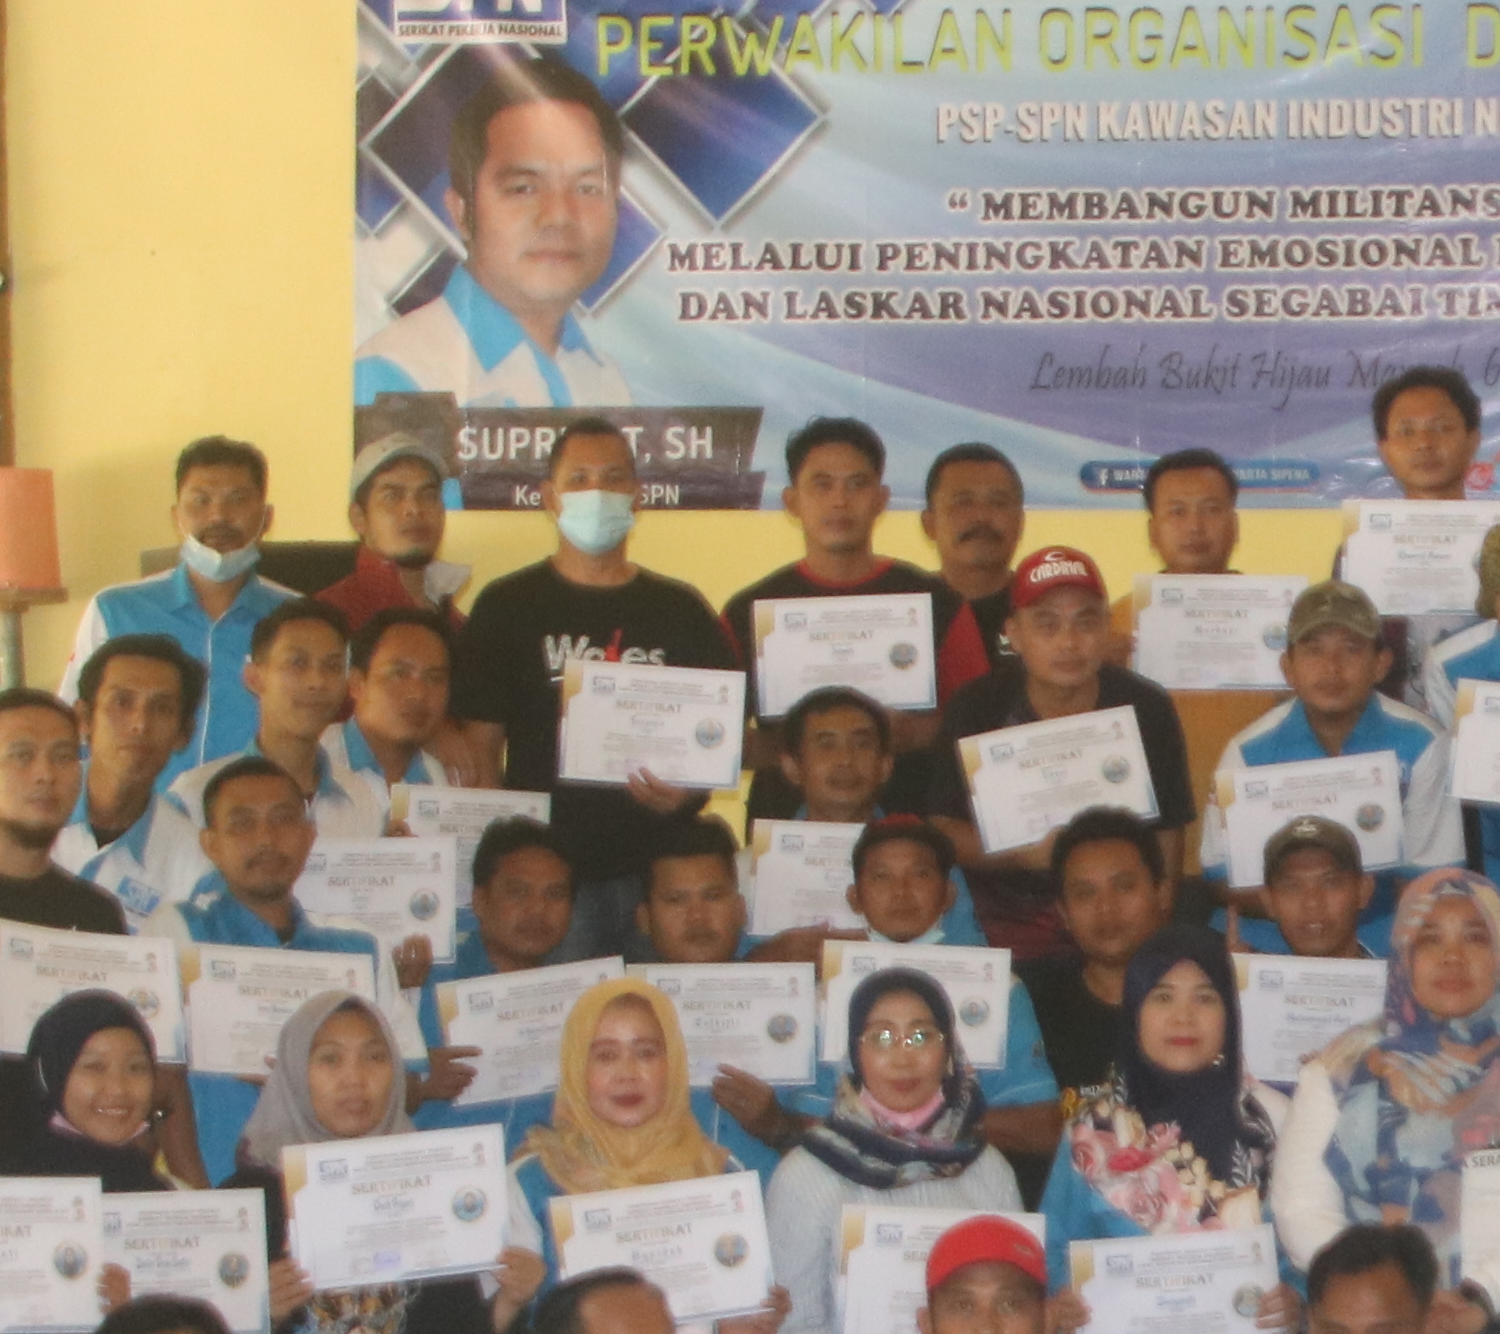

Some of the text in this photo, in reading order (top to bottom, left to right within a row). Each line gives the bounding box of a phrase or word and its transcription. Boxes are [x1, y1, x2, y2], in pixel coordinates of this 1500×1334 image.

[399, 23, 562, 36] SERIKAT PEKEJA NASIONAL
[597, 7, 1012, 76] PERWAKILAN
[1038, 3, 1424, 71] ORGANISASI
[936, 99, 1088, 144] PSP-SPN
[1098, 97, 1281, 143] KAWASAN
[1286, 97, 1464, 140] INDUSTRI
[979, 188, 1276, 222] MEMBANGUN
[666, 240, 865, 273] MELALUI
[875, 238, 1204, 272] PENINGKATAN
[1216, 235, 1485, 270] EMOSIONAL
[677, 290, 771, 322] DAN
[783, 289, 969, 322] LASKAR
[980, 286, 1216, 321] NASIONAL
[1224, 284, 1427, 319] SEGABAI
[1029, 346, 1149, 391] Lembah
[1159, 346, 1239, 394] Bukit
[1251, 348, 1332, 411] Hijau
[665, 426, 714, 460] SH
